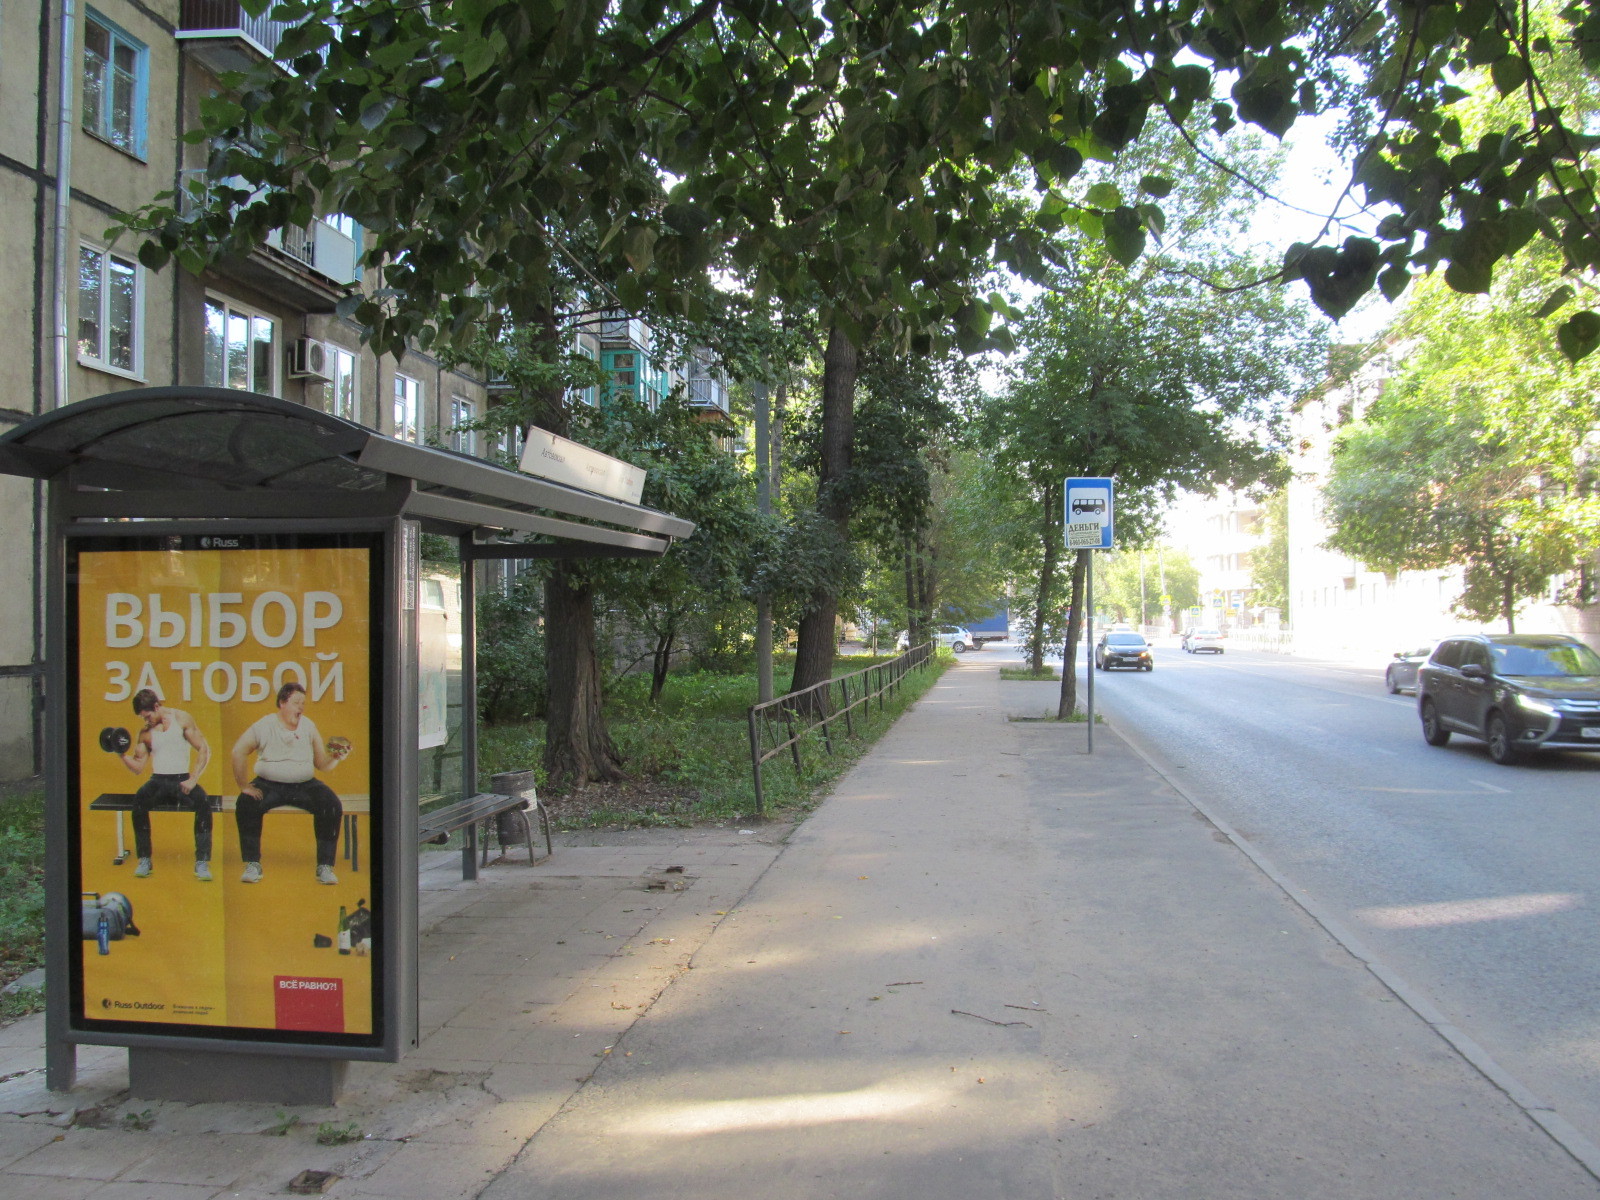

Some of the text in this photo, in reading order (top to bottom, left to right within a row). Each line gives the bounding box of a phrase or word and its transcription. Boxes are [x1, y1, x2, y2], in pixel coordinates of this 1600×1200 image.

[1069, 523, 1099, 532] ДЕНЬГИ
[212, 537, 239, 548] Russ
[106, 591, 343, 648] ВЫБОР
[104, 652, 345, 703] ЗА ТОБОЙ
[279, 979, 338, 991] ВСЁ РАВНО?!
[114, 1000, 132, 1009] Russ
[134, 1000, 165, 1010] Outdoor
